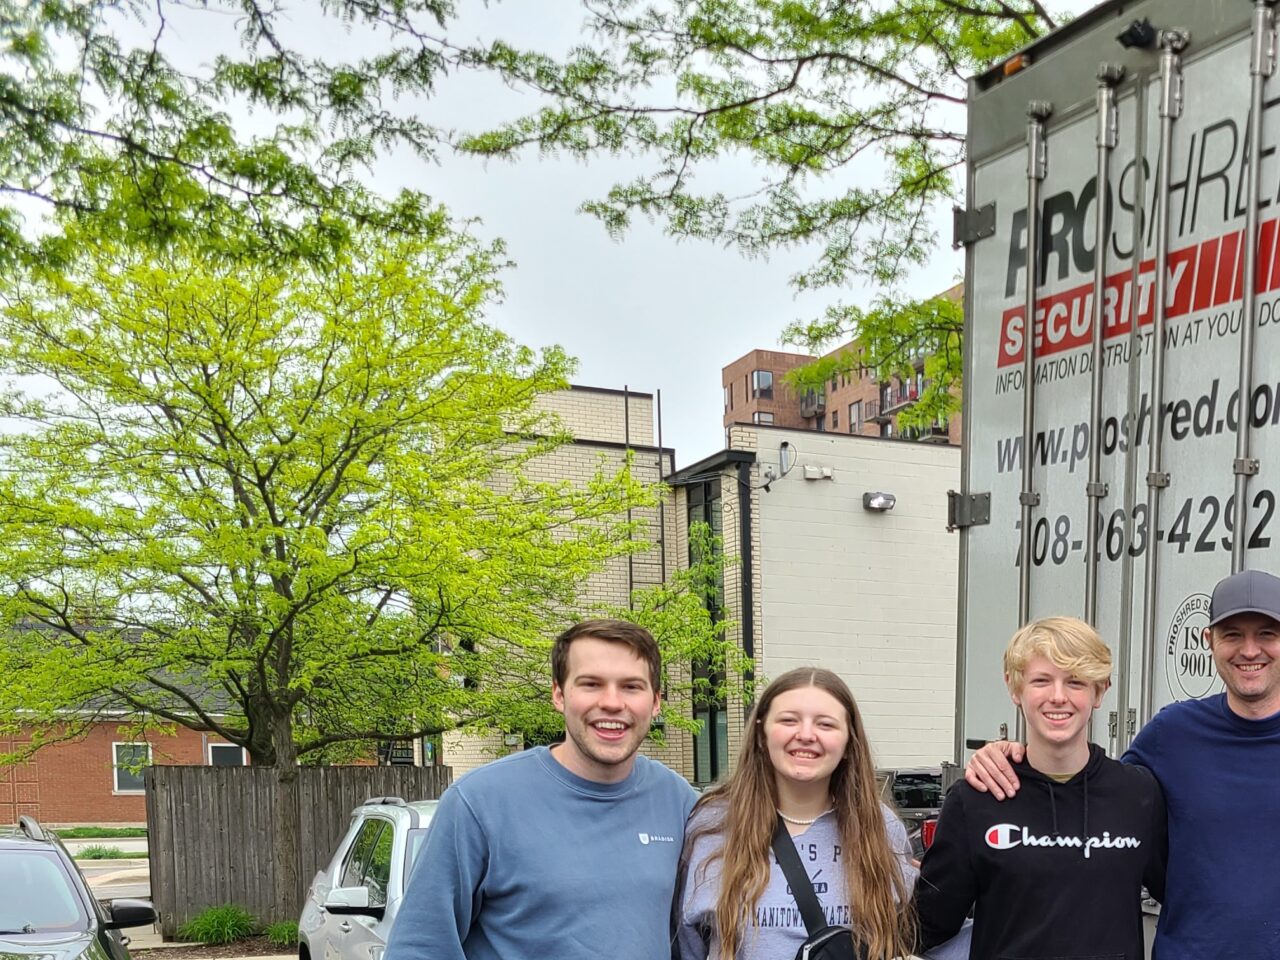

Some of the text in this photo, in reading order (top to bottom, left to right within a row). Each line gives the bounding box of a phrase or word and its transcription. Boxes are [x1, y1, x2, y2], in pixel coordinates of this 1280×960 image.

[995, 355, 1077, 395] INFOMATION
[1182, 319, 1203, 347] AT
[1208, 308, 1243, 340] YOU
[1168, 598, 1202, 656] PROSHRED
[1179, 653, 1214, 677] 9001
[985, 823, 1141, 859] Champion
